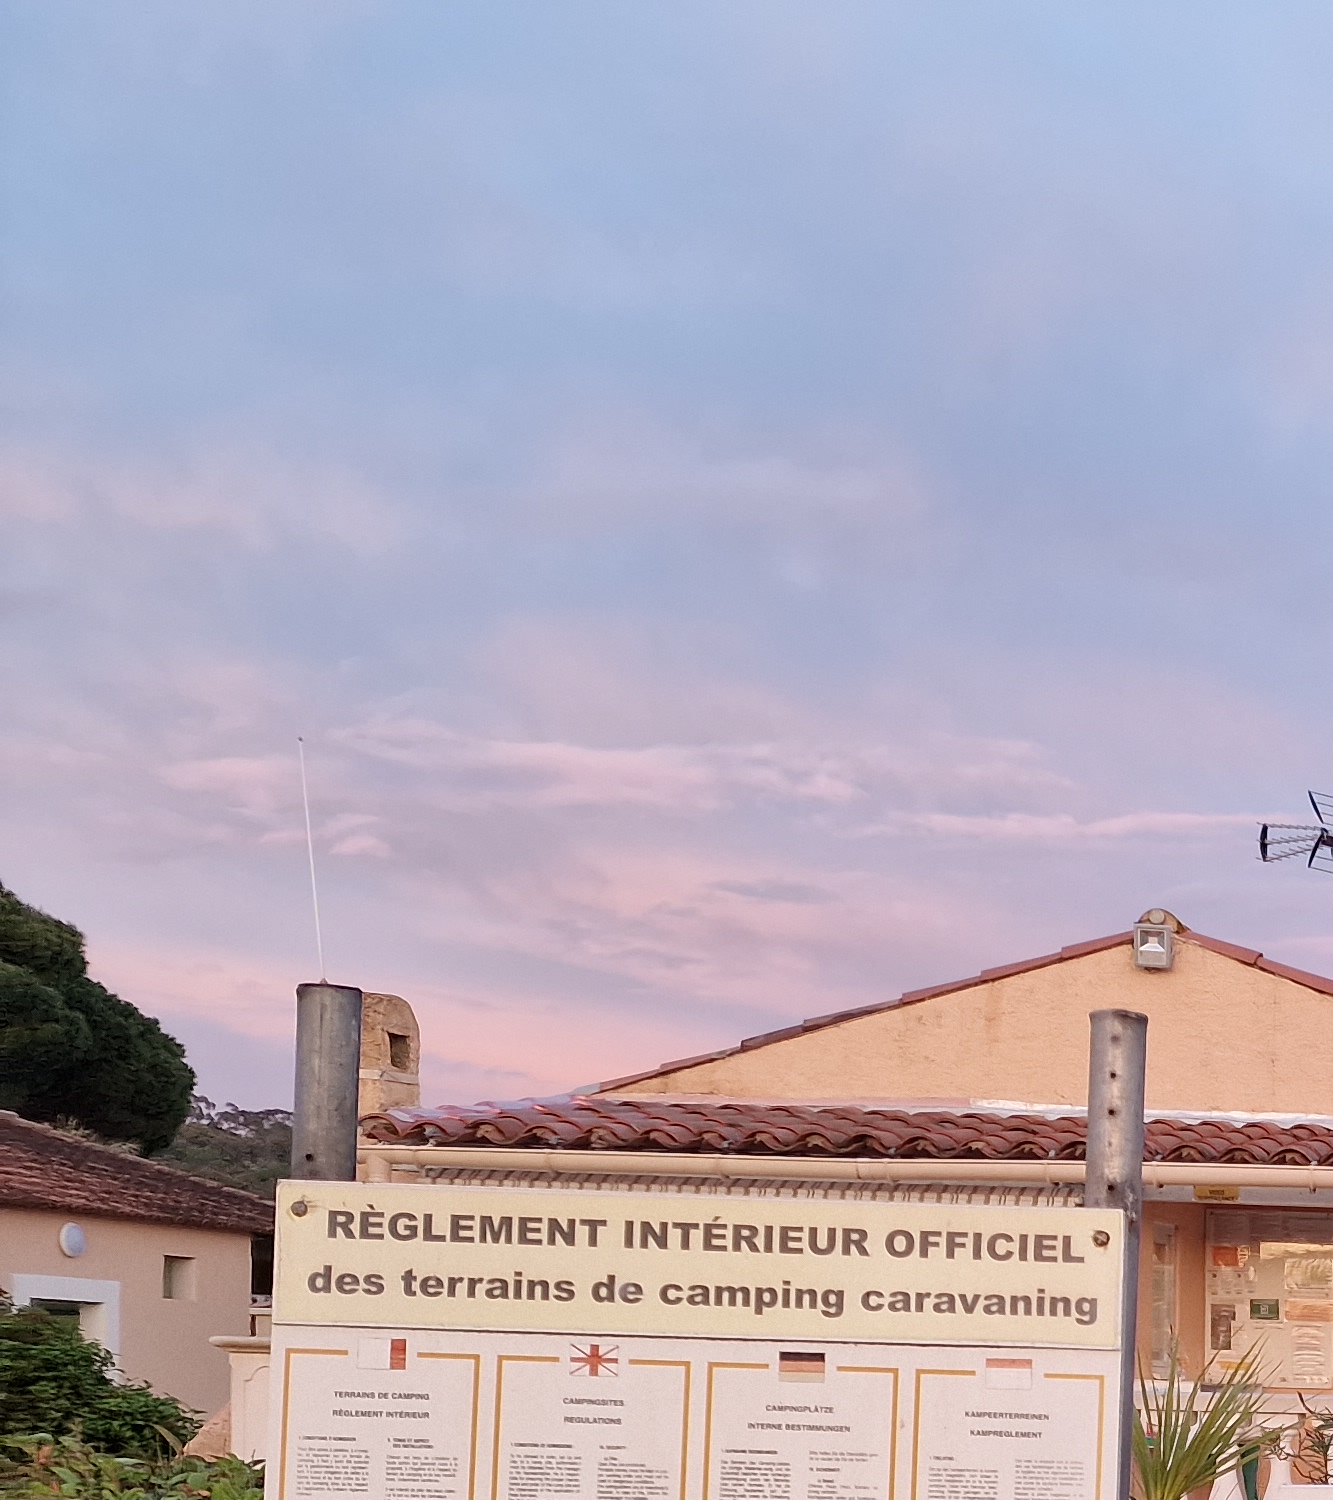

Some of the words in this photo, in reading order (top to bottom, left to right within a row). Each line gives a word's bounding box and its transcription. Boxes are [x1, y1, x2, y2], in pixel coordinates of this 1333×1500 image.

[326, 1204, 607, 1247] RÈGLEMENT
[623, 1215, 869, 1257] INTÉRIEUR
[884, 1230, 1085, 1263] OFFICIEL
[307, 1265, 386, 1296] des
[401, 1270, 575, 1301] terrains
[591, 1275, 644, 1304] de
[658, 1279, 846, 1317] camping
[860, 1284, 1099, 1326] caravaning
[334, 1391, 375, 1399] TERRAINS
[378, 1392, 389, 1400] DE
[392, 1392, 429, 1400] CAMPING
[563, 1397, 624, 1407] CAMPINGSITES
[332, 1408, 379, 1418] RÈGLEMENT
[383, 1409, 429, 1419] INTÉRIEUR
[965, 1411, 1050, 1421] KAMPEERTERREINEN
[564, 1416, 622, 1425] REGULATIONS
[748, 1422, 782, 1431] INTERNE
[785, 1423, 850, 1433] BESTIMMUNGEN
[970, 1429, 1042, 1439] KAMPREGLEMENT
